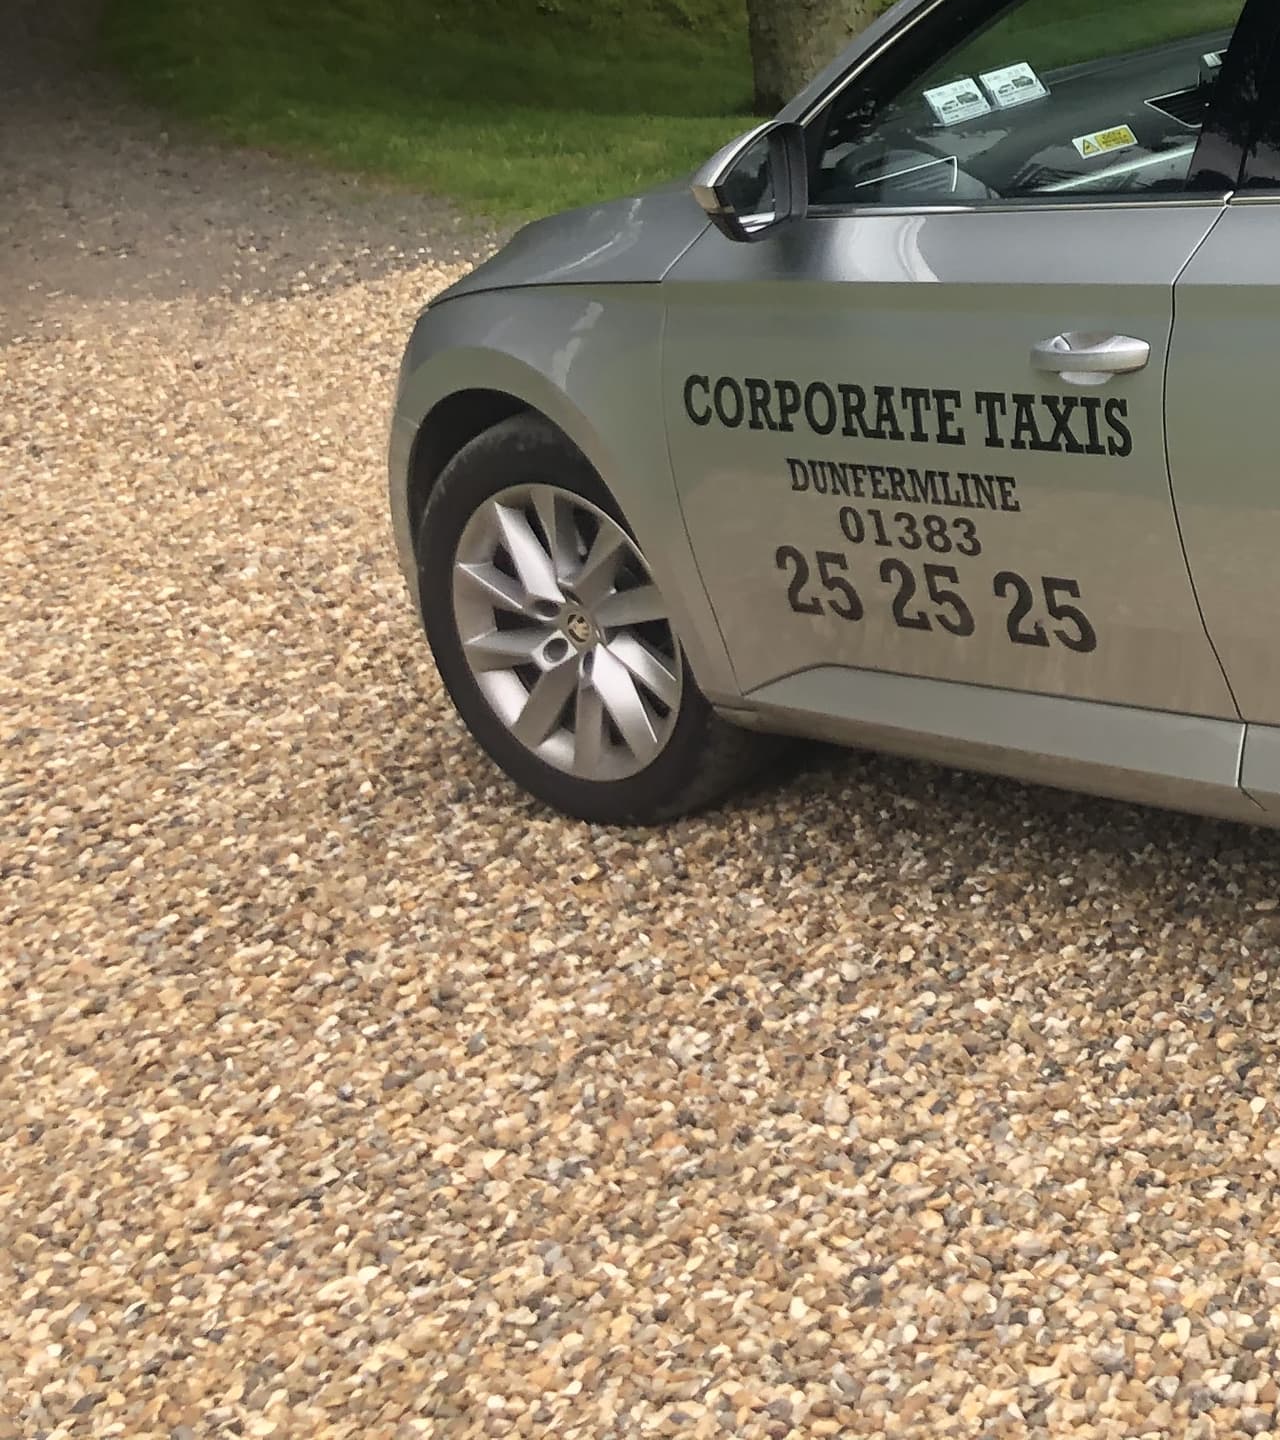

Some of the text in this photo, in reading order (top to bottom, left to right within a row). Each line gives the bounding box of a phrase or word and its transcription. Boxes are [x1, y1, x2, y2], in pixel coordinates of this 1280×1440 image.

[683, 374, 1134, 457] CORPORATE TAXIS
[786, 457, 1021, 513] DUNFERMLINE
[839, 506, 982, 557] 01383
[775, 545, 1098, 654] 25 25 25
